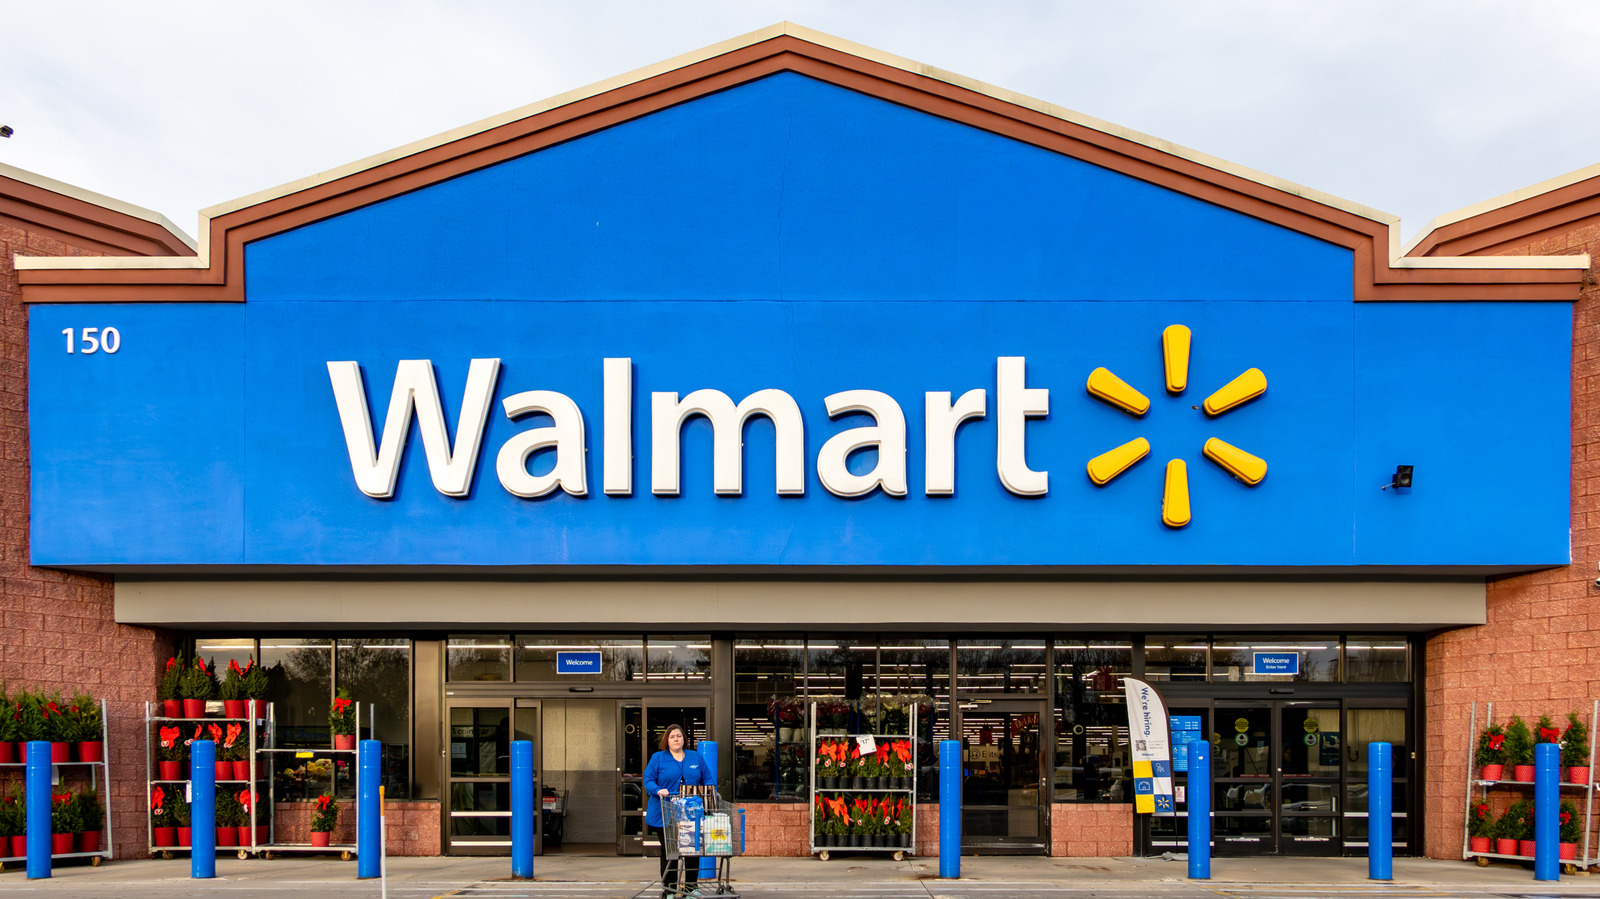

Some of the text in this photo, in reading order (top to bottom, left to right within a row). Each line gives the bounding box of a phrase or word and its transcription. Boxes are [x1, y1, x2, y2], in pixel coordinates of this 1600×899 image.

[61, 326, 121, 354] 150
[326, 356, 1050, 498] Walmart
[1141, 687, 1152, 737] We're hiring.
